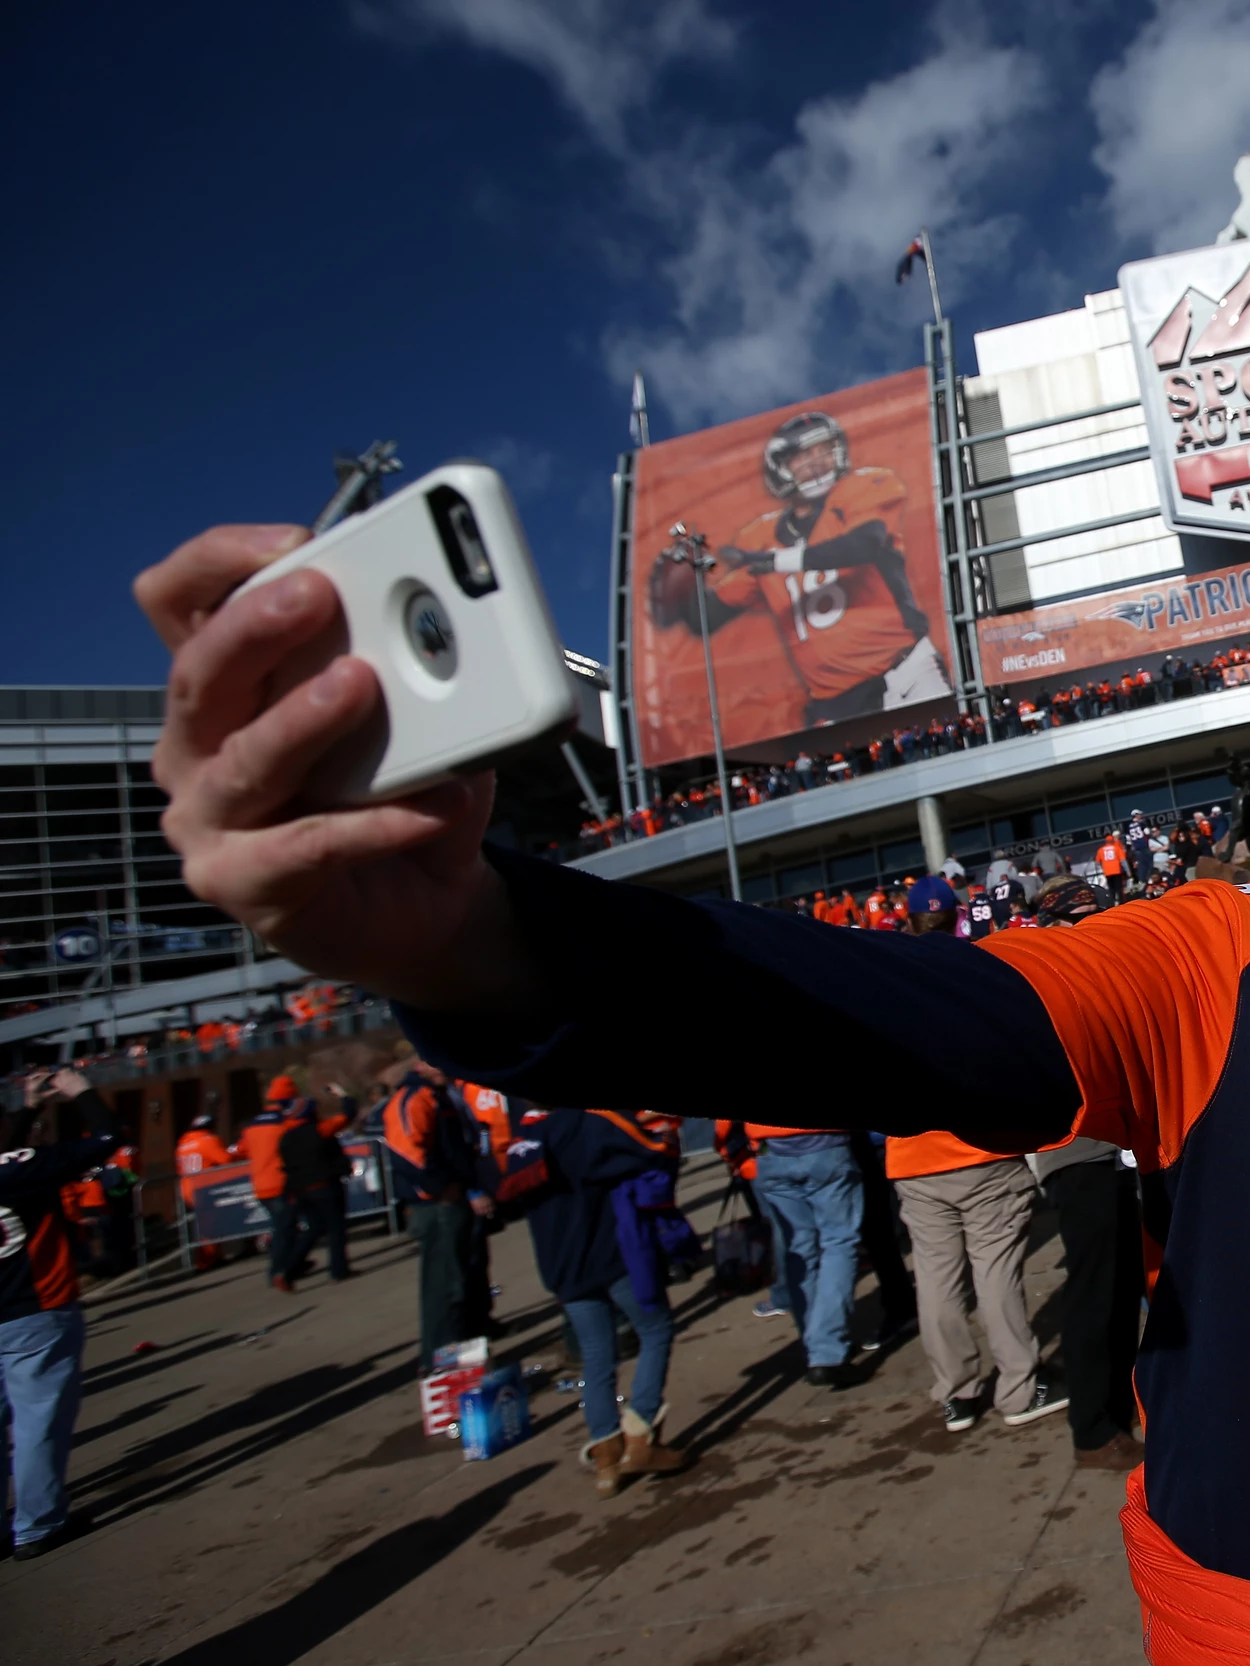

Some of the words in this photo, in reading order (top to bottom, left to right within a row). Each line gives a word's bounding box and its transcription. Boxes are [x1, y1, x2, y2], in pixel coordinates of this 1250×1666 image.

[785, 568, 848, 642] 18
[1002, 647, 1066, 673] #NEvsDEN
[1088, 823, 1124, 839] TEAM
[1149, 811, 1184, 826] TORE
[994, 884, 1011, 900] 27
[971, 905, 992, 922] 58
